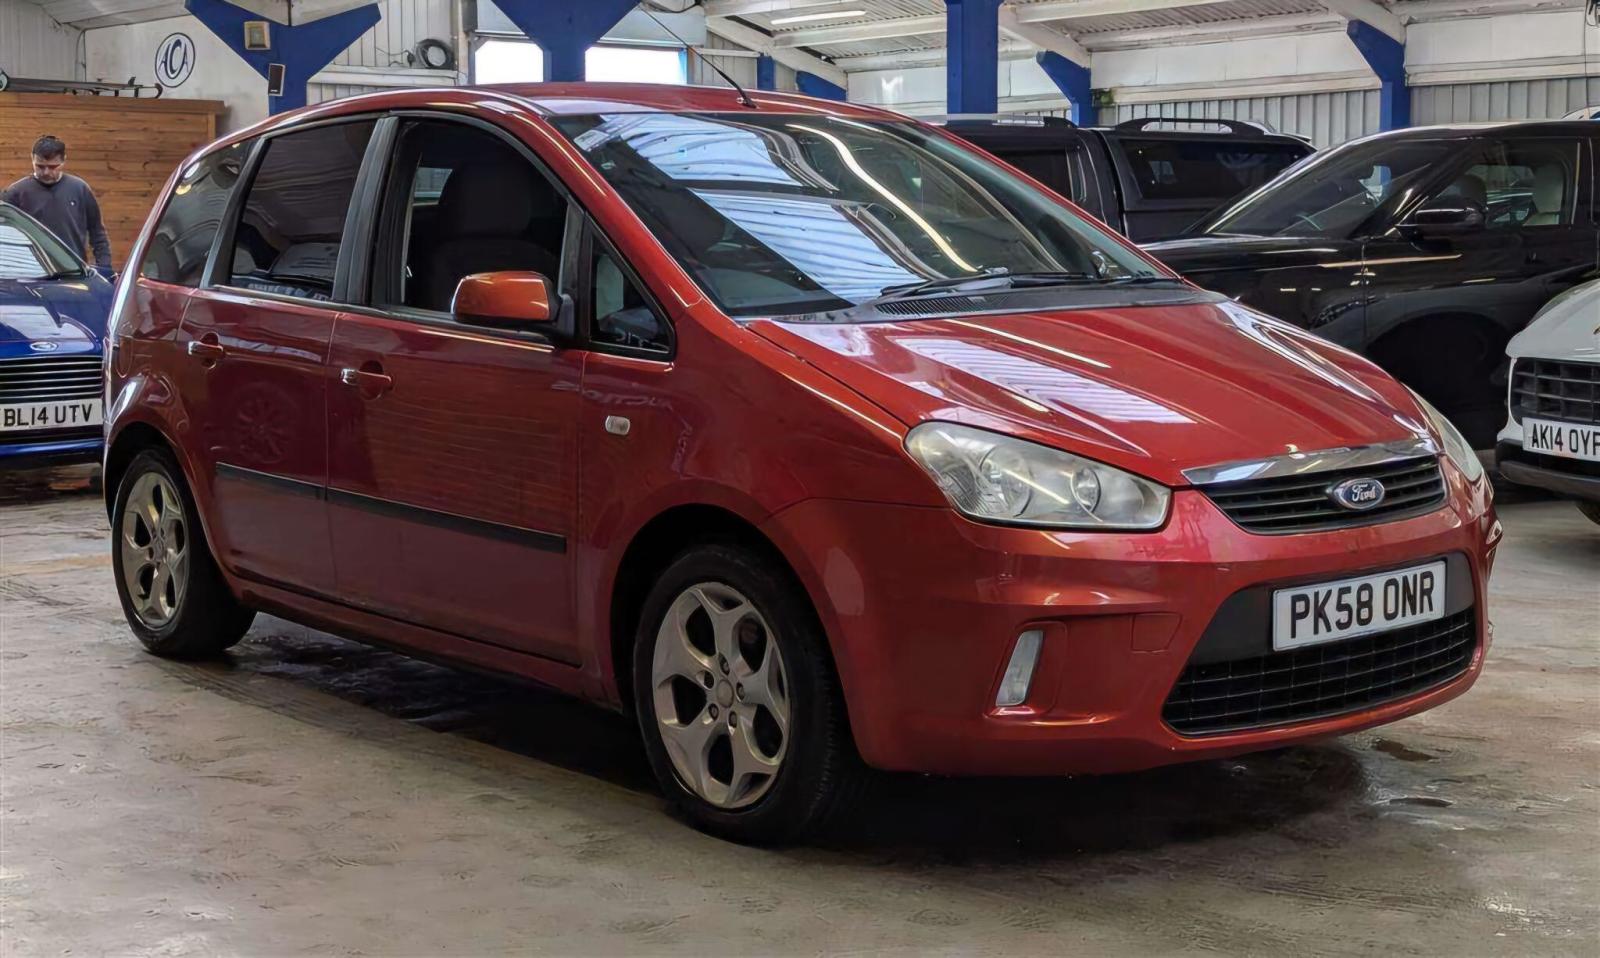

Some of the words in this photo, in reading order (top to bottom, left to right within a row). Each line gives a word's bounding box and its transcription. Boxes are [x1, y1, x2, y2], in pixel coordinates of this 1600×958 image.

[3, 406, 49, 427] BL14
[54, 403, 93, 424] UTV
[1531, 422, 1564, 452] AK14
[1351, 483, 1377, 502] Ford
[1290, 582, 1374, 639] PK58
[1383, 570, 1435, 622] ONR
